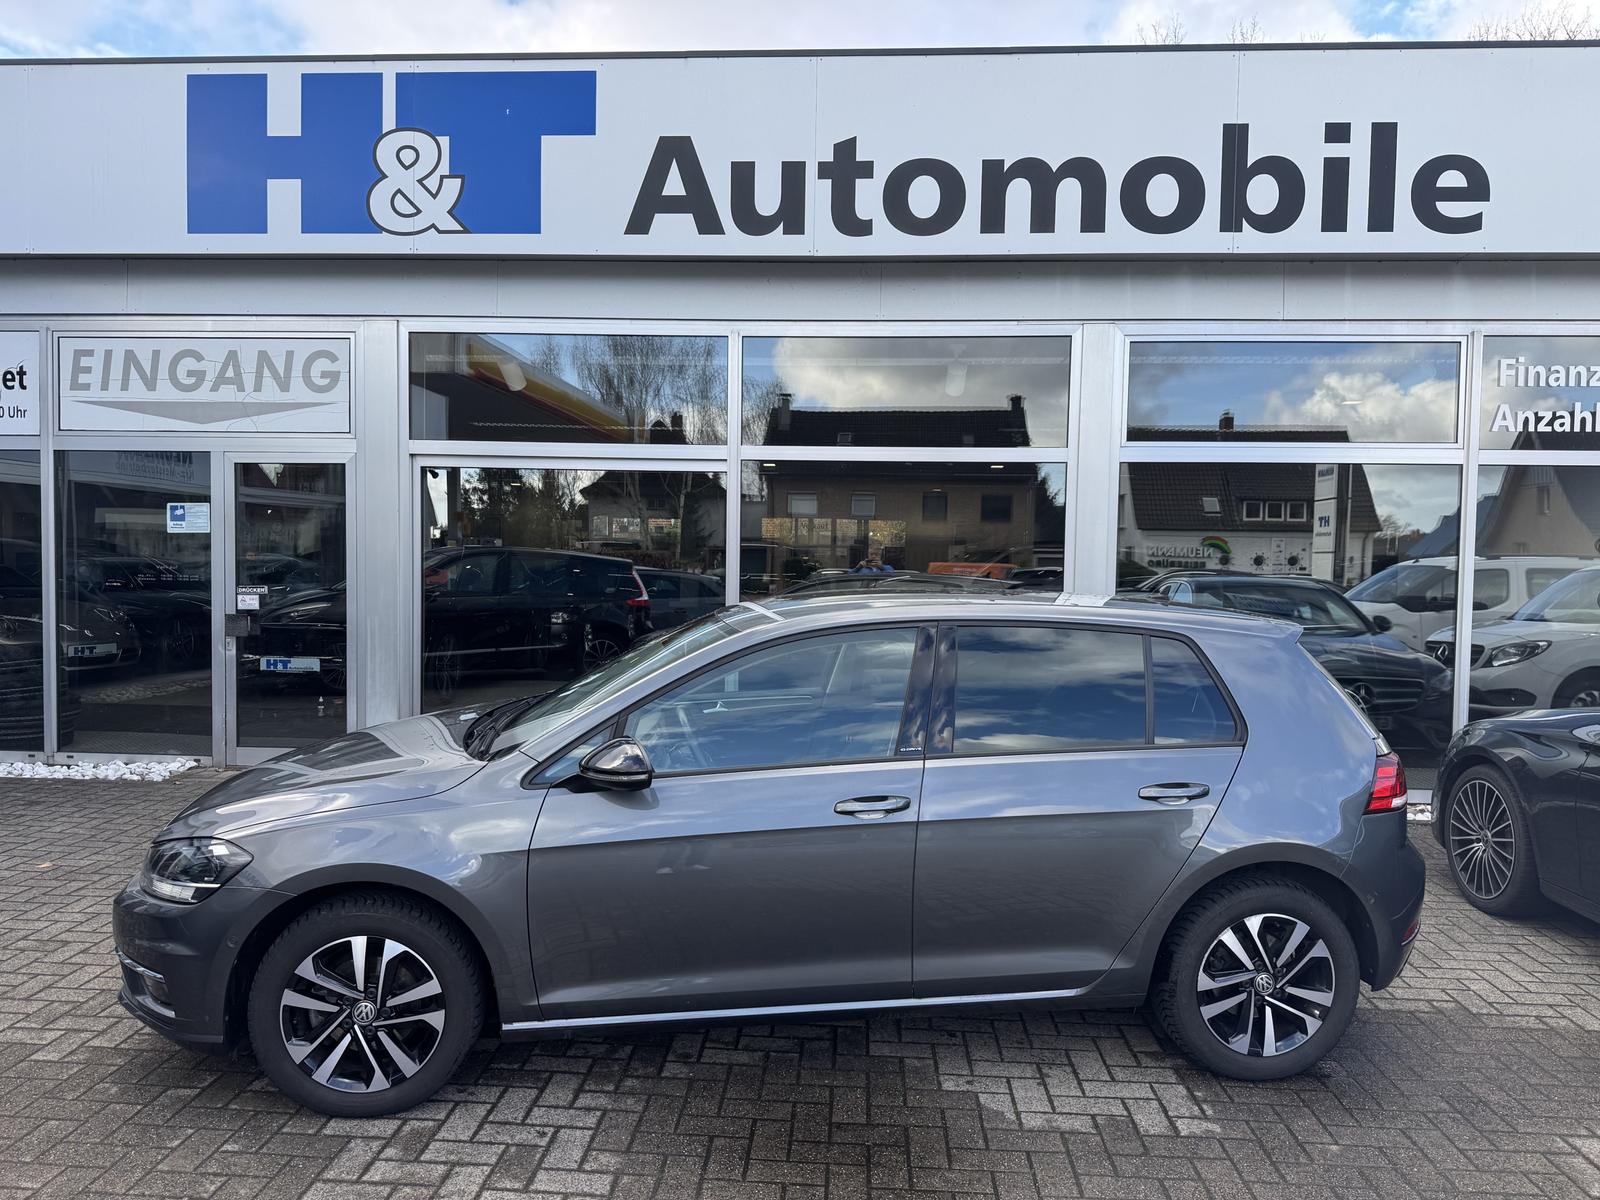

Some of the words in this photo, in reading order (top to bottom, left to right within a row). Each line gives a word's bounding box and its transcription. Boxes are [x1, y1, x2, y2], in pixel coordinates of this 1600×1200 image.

[186, 70, 597, 236] H&T
[624, 122, 1491, 237] Automobile
[0, 365, 27, 394] et
[69, 347, 342, 394] EINGANG
[1498, 356, 1600, 387] Finanz
[8, 405, 27, 418] Uhr
[1490, 401, 1600, 433] Anzahl
